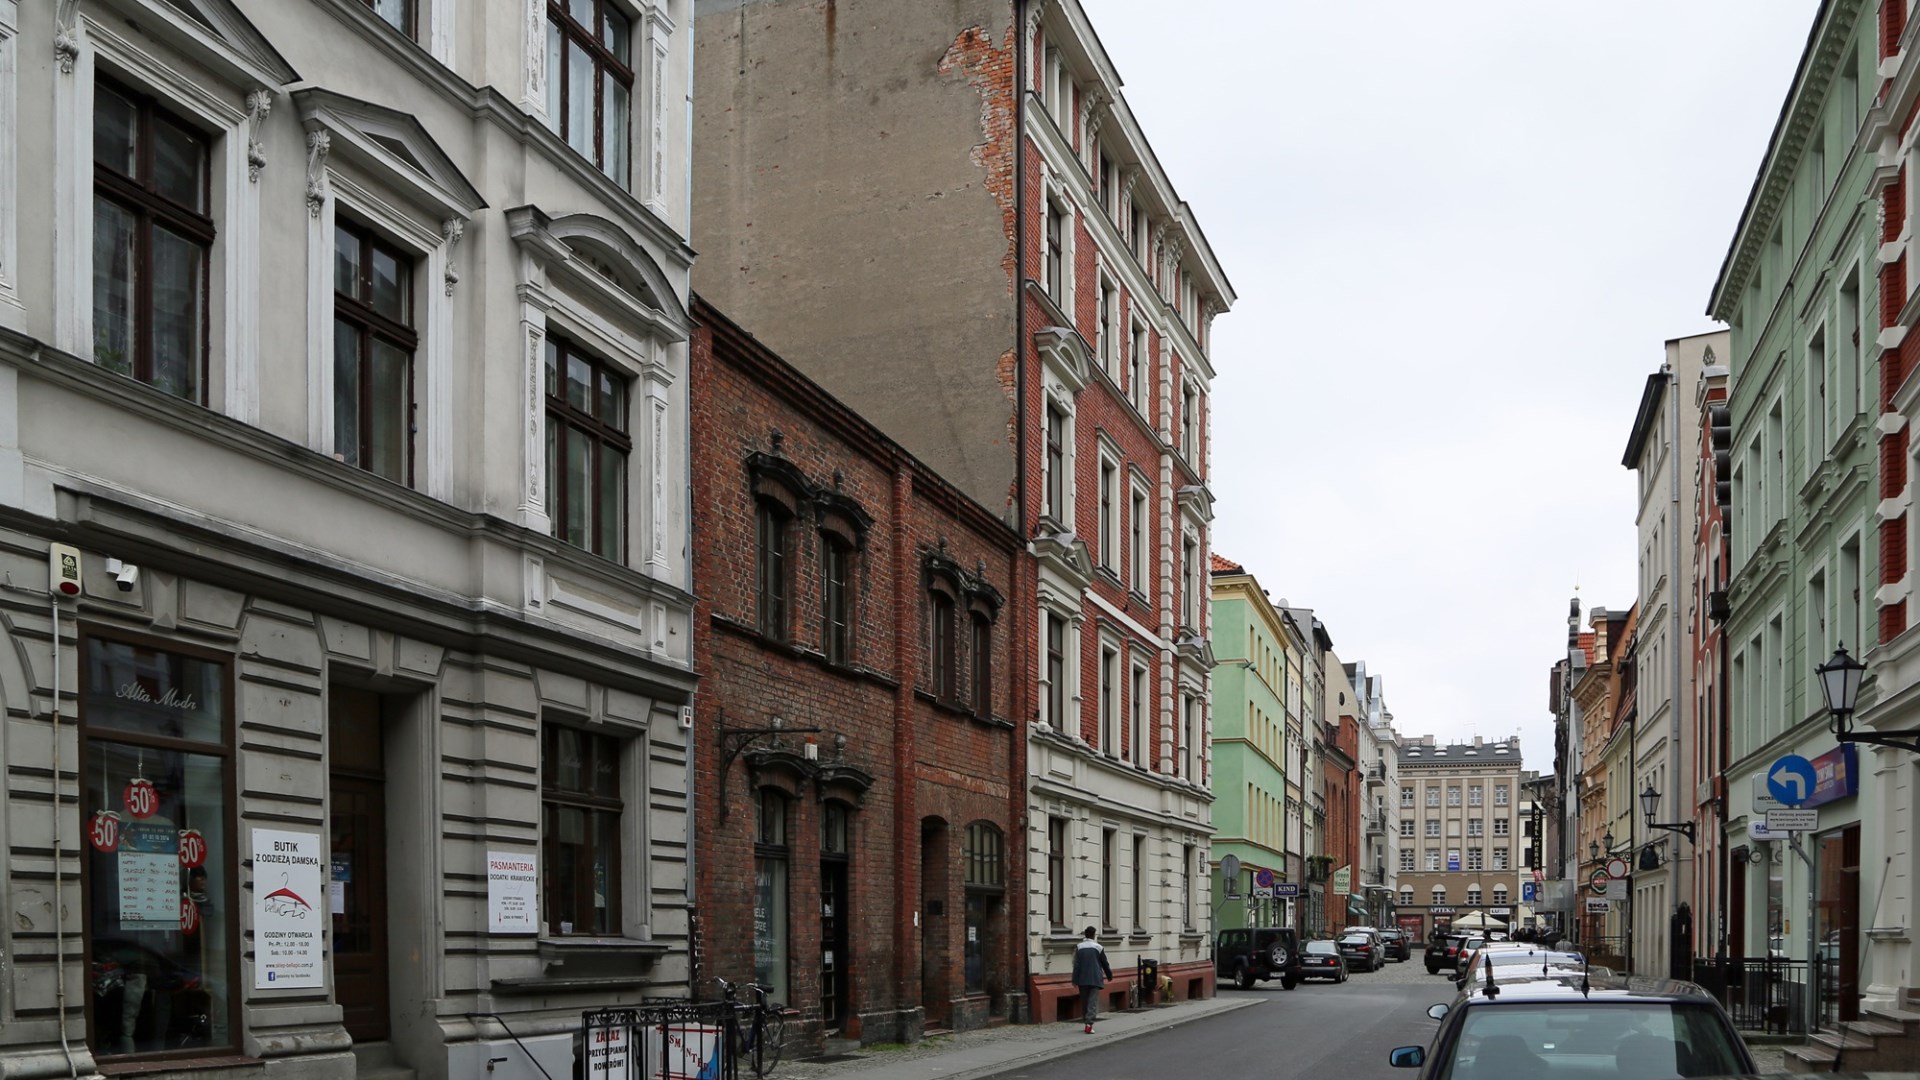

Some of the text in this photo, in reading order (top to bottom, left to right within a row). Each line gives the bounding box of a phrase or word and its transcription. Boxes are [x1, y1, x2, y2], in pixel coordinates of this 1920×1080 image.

[116, 681, 151, 703] Alta
[91, 819, 118, 847] -50
[274, 841, 298, 853] BUTIK
[256, 854, 260, 862] Z
[262, 853, 291, 865] ODZIEŻĄ
[292, 856, 319, 867] DAMSKĄ
[490, 861, 535, 872] PASMANTERIA
[490, 873, 509, 881] DODATKI
[587, 1045, 627, 1060] PRZYCEPIANIA
